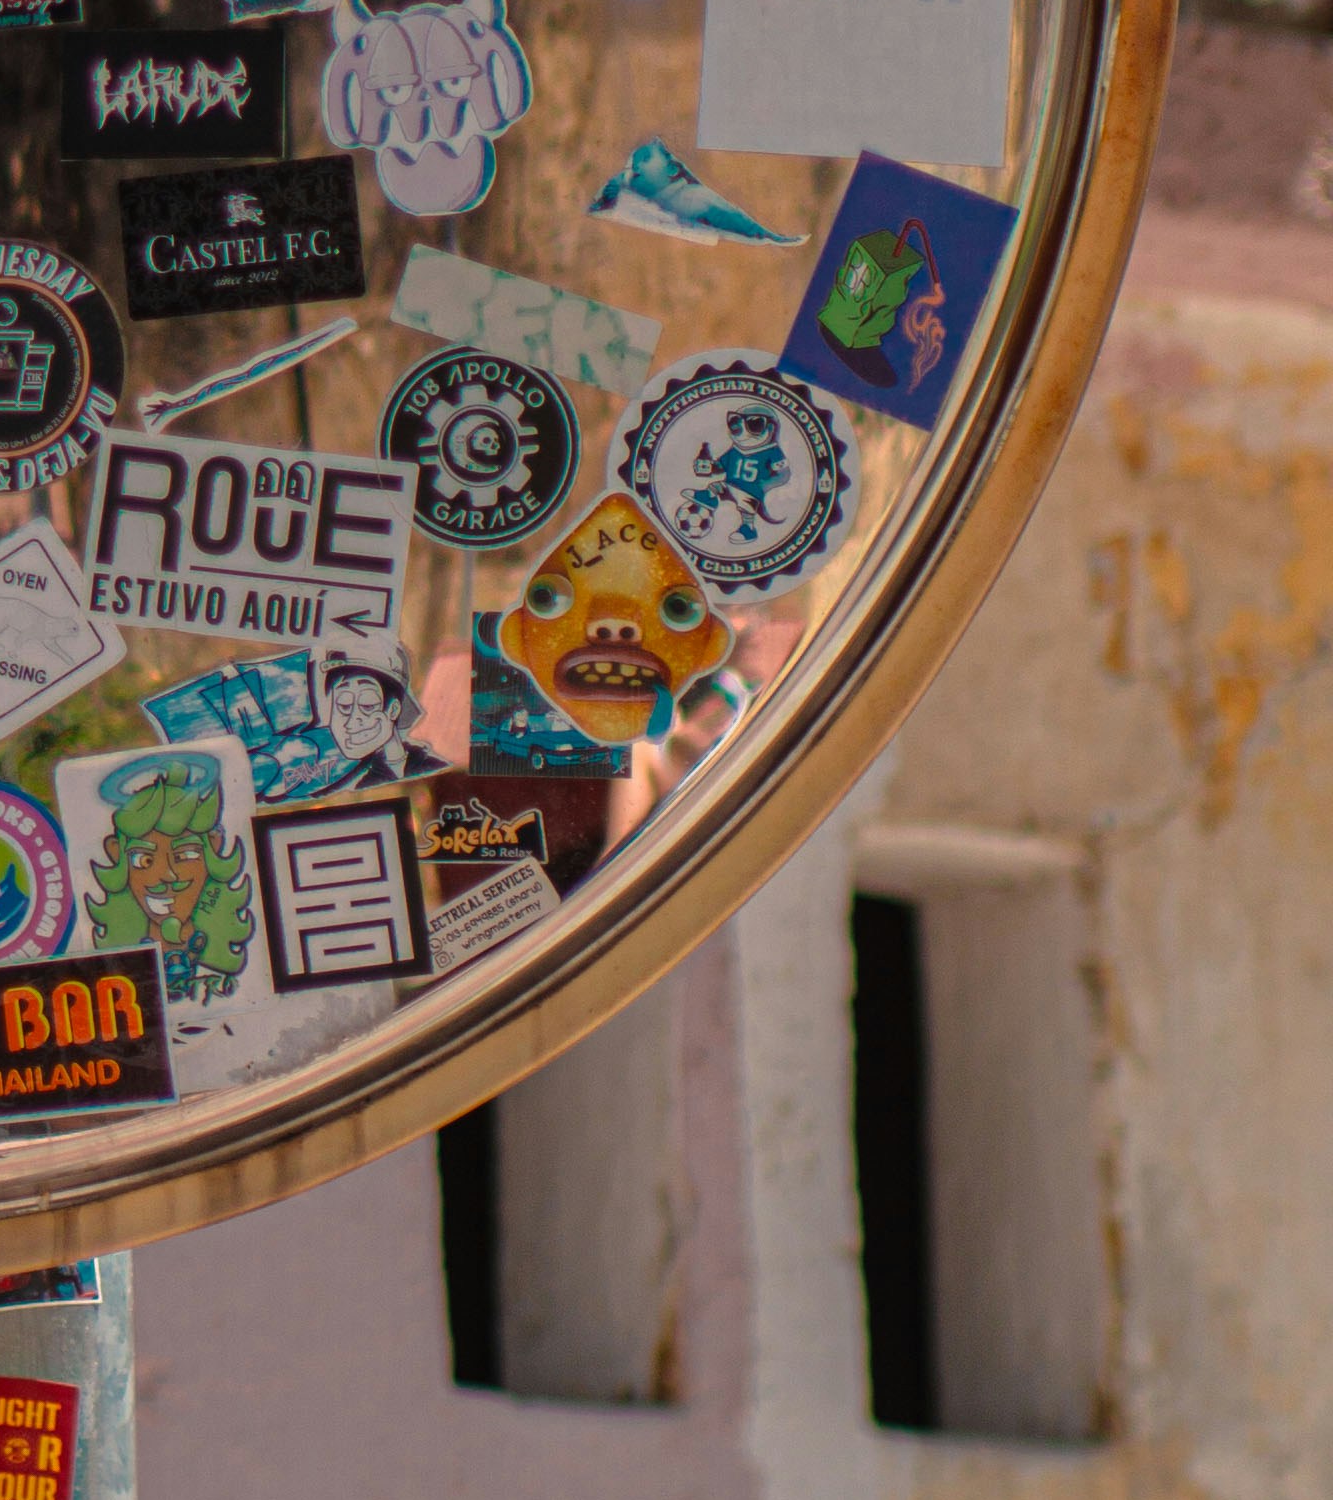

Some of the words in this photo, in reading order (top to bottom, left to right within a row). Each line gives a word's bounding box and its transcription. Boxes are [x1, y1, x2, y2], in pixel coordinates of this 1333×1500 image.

[284, 229, 341, 261] F.C.
[213, 274, 244, 288] since
[246, 269, 280, 284] 2012
[403, 374, 442, 418] 108
[446, 361, 547, 411] APOLLO
[644, 379, 756, 450] NOTTINGHAM
[756, 381, 829, 460] TOULOUSE
[733, 458, 758, 482] 15
[431, 489, 543, 530] GARAGE
[702, 552, 747, 576] Club
[747, 501, 826, 573] Hannover
[2, 568, 48, 592] OYEN
[89, 572, 227, 626] ESTUVO
[238, 588, 329, 638] AQUÍ
[481, 846, 496, 858] So
[499, 847, 533, 859] Relax
[35, 850, 65, 939] WORLD
[429, 883, 484, 936] LECTRICAL
[481, 864, 535, 904] SERVICES
[1, 975, 144, 1053] BAR
